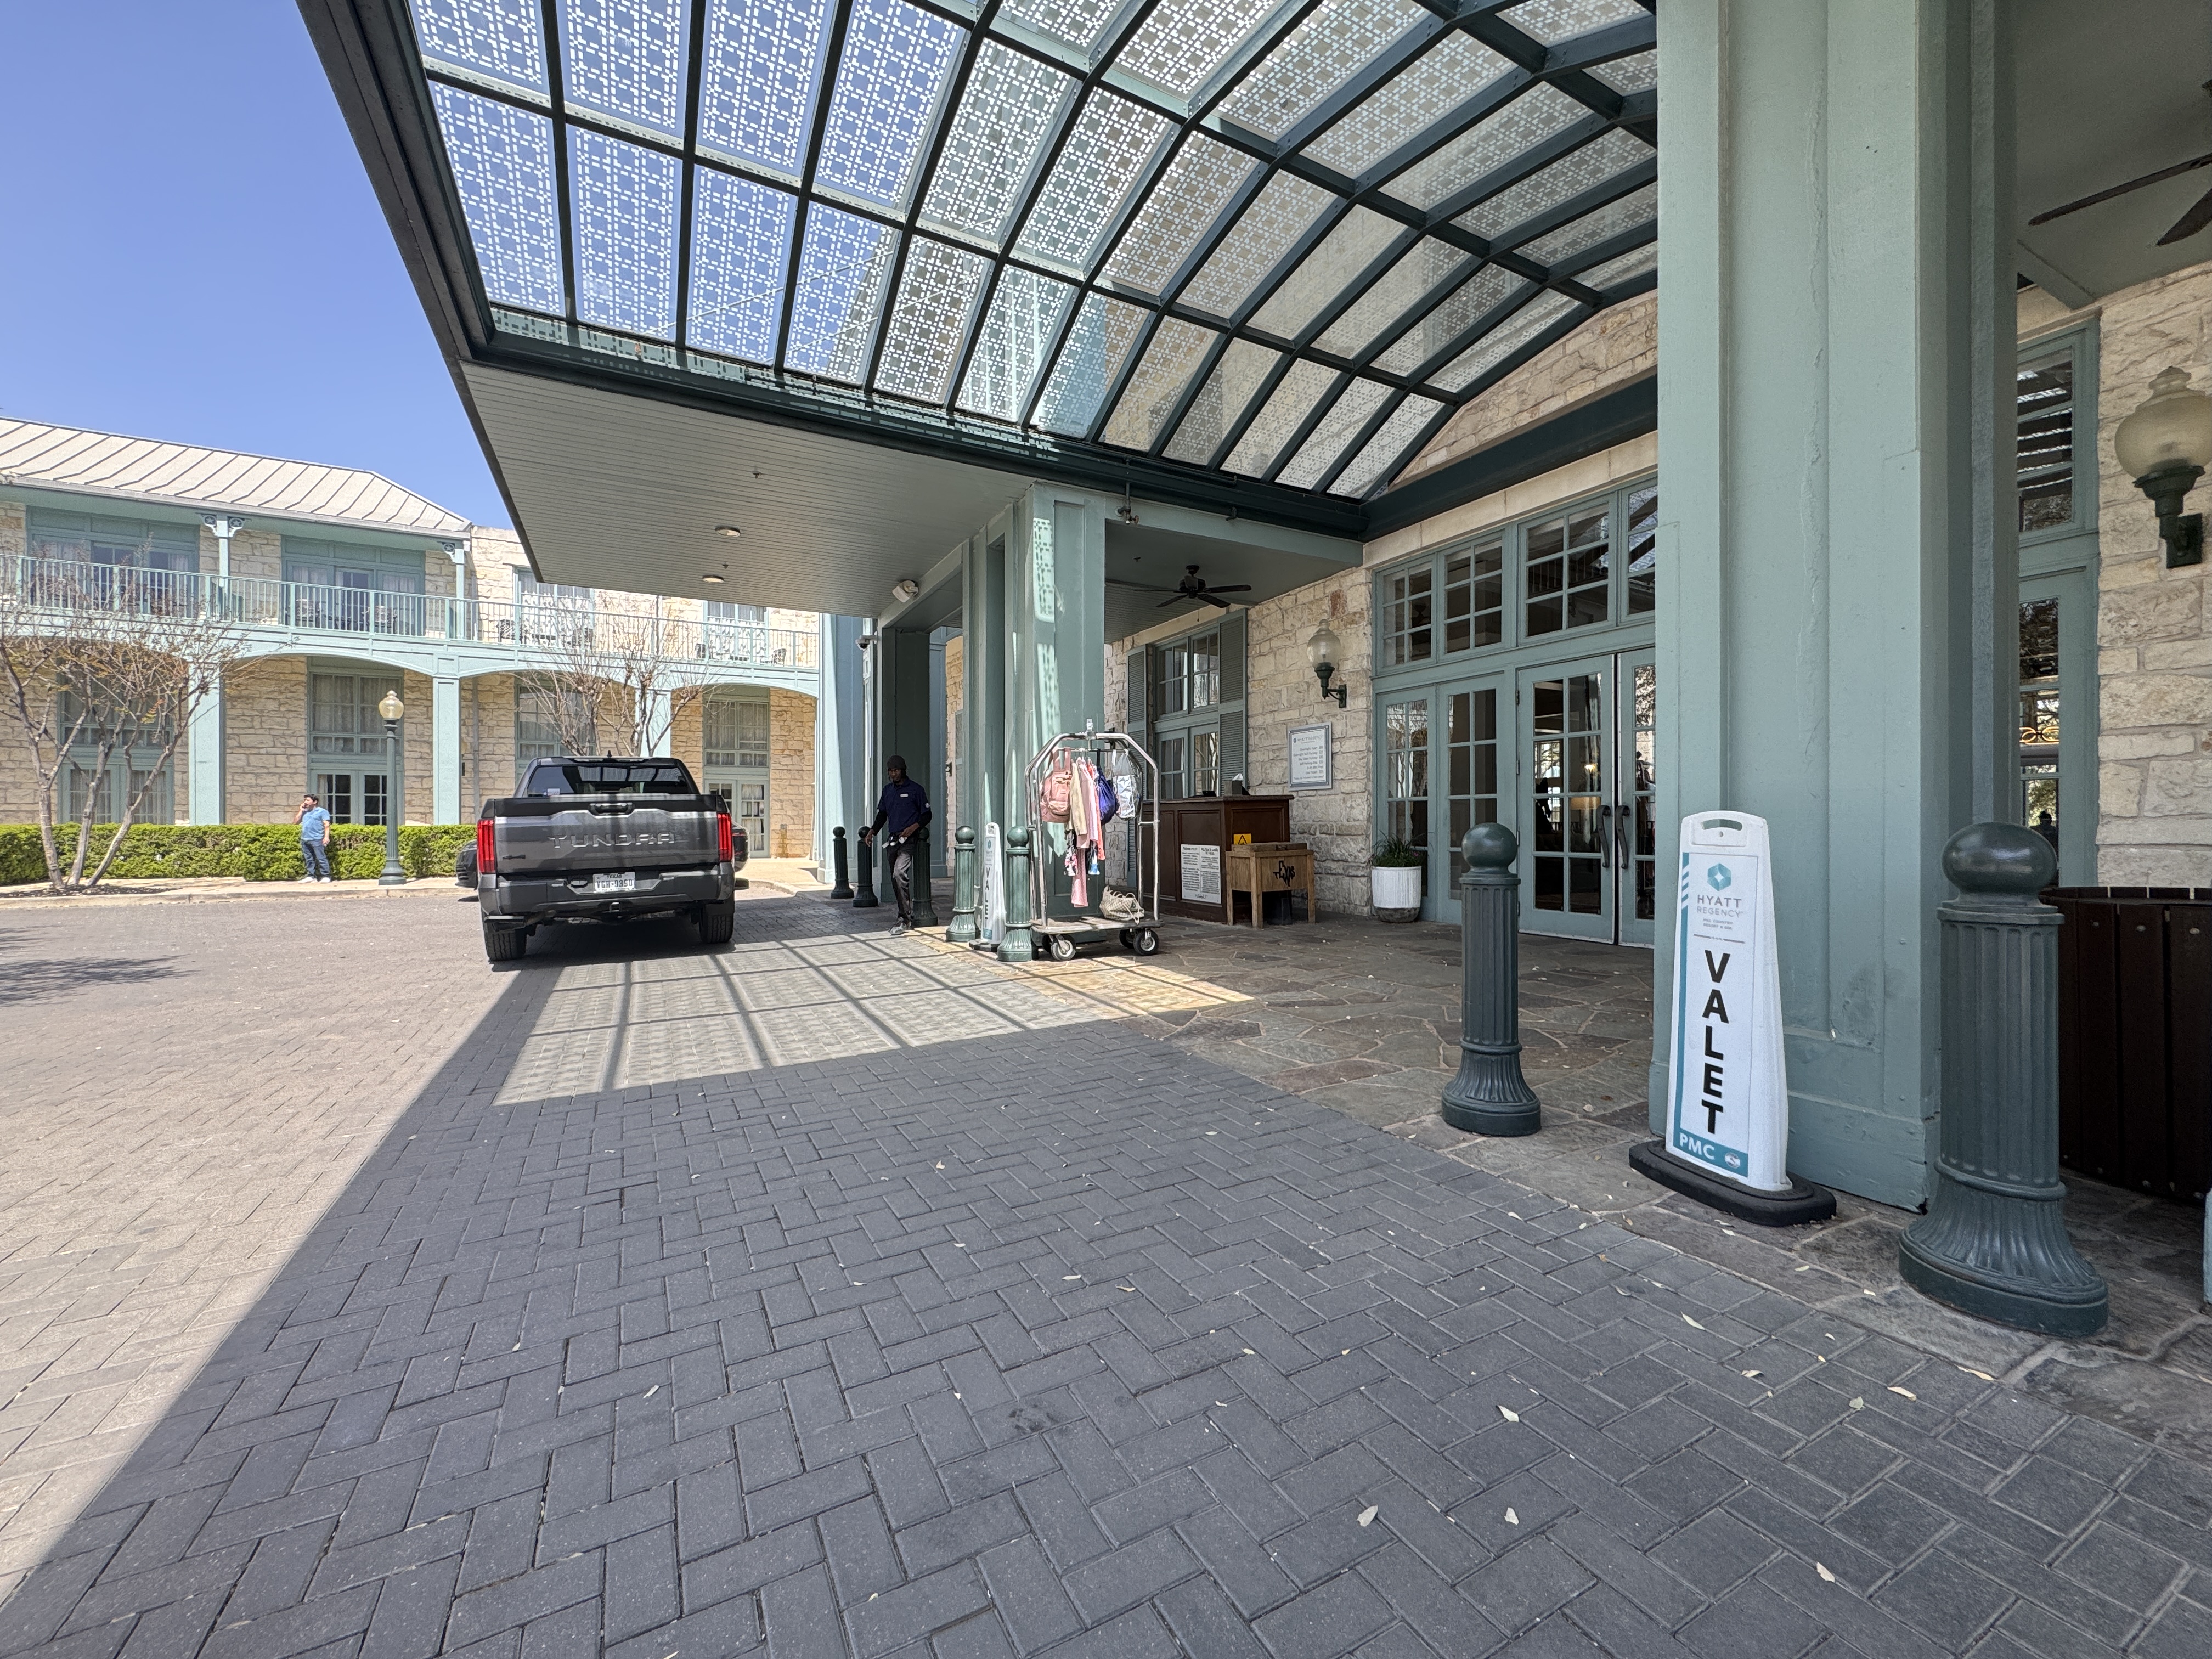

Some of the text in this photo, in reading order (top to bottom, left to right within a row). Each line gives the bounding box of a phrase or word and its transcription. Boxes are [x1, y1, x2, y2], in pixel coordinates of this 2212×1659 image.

[548, 833, 675, 849] TUNDRA
[1697, 894, 1742, 908] HYATT
[1697, 906, 1741, 918] REGENCY
[1702, 949, 1731, 1135] VALET
[1679, 1132, 1715, 1160] PMC
